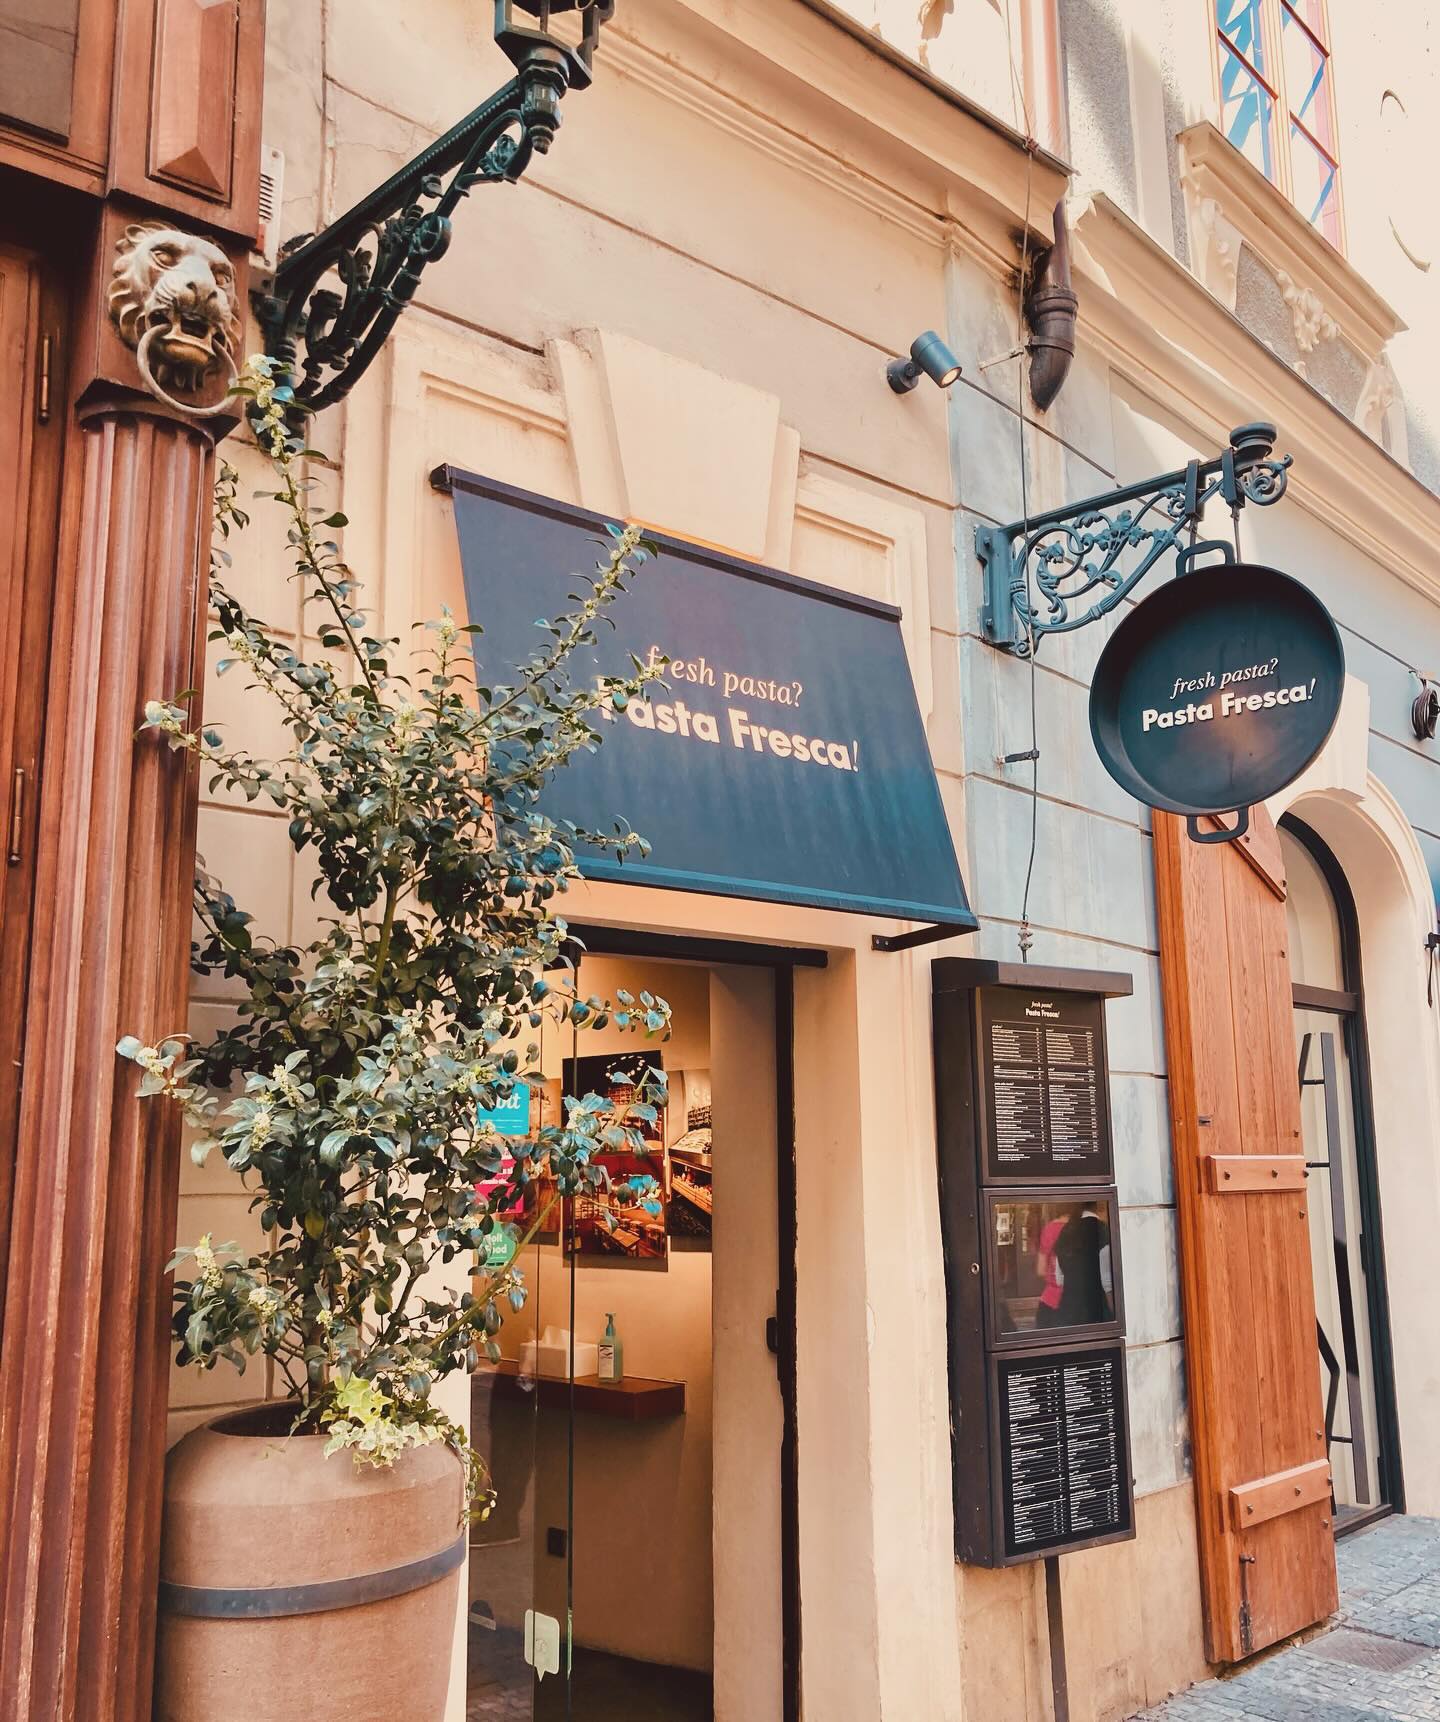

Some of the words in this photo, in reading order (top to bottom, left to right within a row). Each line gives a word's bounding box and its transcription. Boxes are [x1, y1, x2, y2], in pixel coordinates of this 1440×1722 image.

[646, 645, 716, 687] fesh
[722, 671, 804, 708] pasta?
[1142, 702, 1214, 732] Pasta
[1221, 678, 1317, 717] Fresca!
[1170, 672, 1215, 700] fresh
[1219, 658, 1279, 690] pasta?
[727, 708, 860, 773] Fresca!
